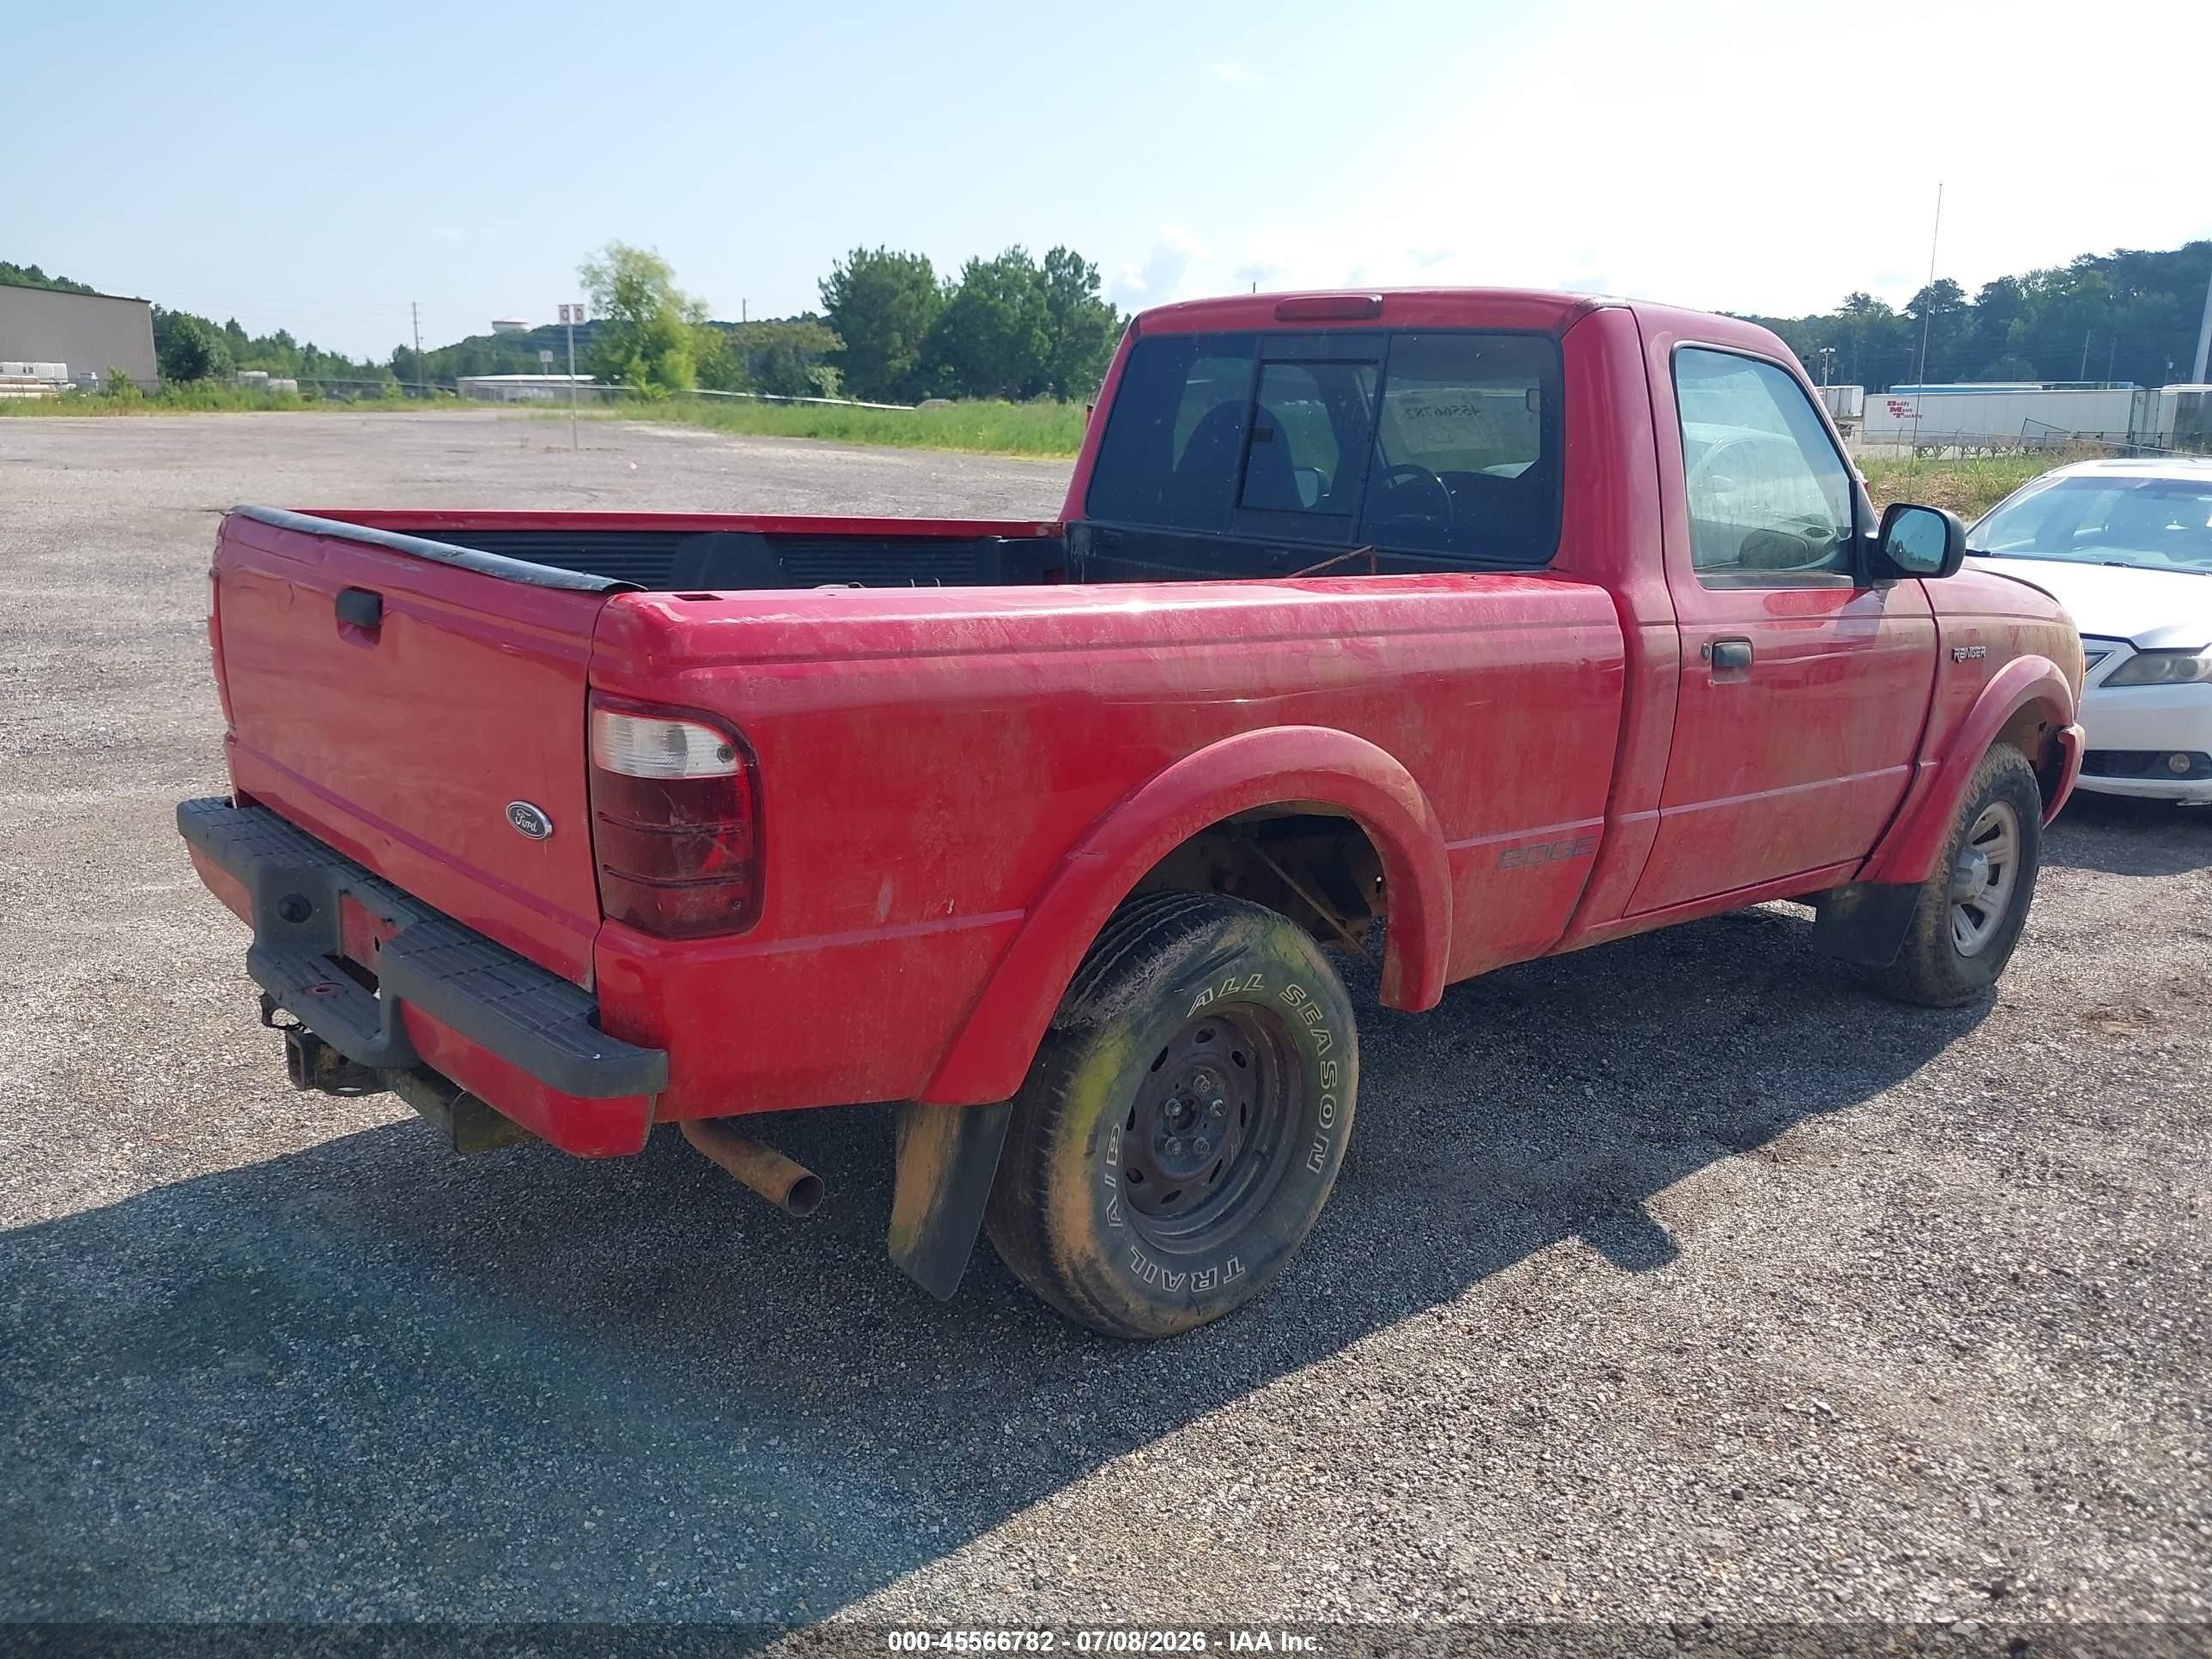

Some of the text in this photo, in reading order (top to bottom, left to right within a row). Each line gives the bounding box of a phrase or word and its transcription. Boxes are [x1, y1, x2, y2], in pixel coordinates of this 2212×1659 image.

[1951, 646, 1986, 663] RANGER
[515, 808, 538, 832] Ford
[1498, 835, 1597, 871] EDGE
[1185, 972, 1338, 1176] ALL SEASON
[1129, 1245, 1247, 1293] TRAIL
